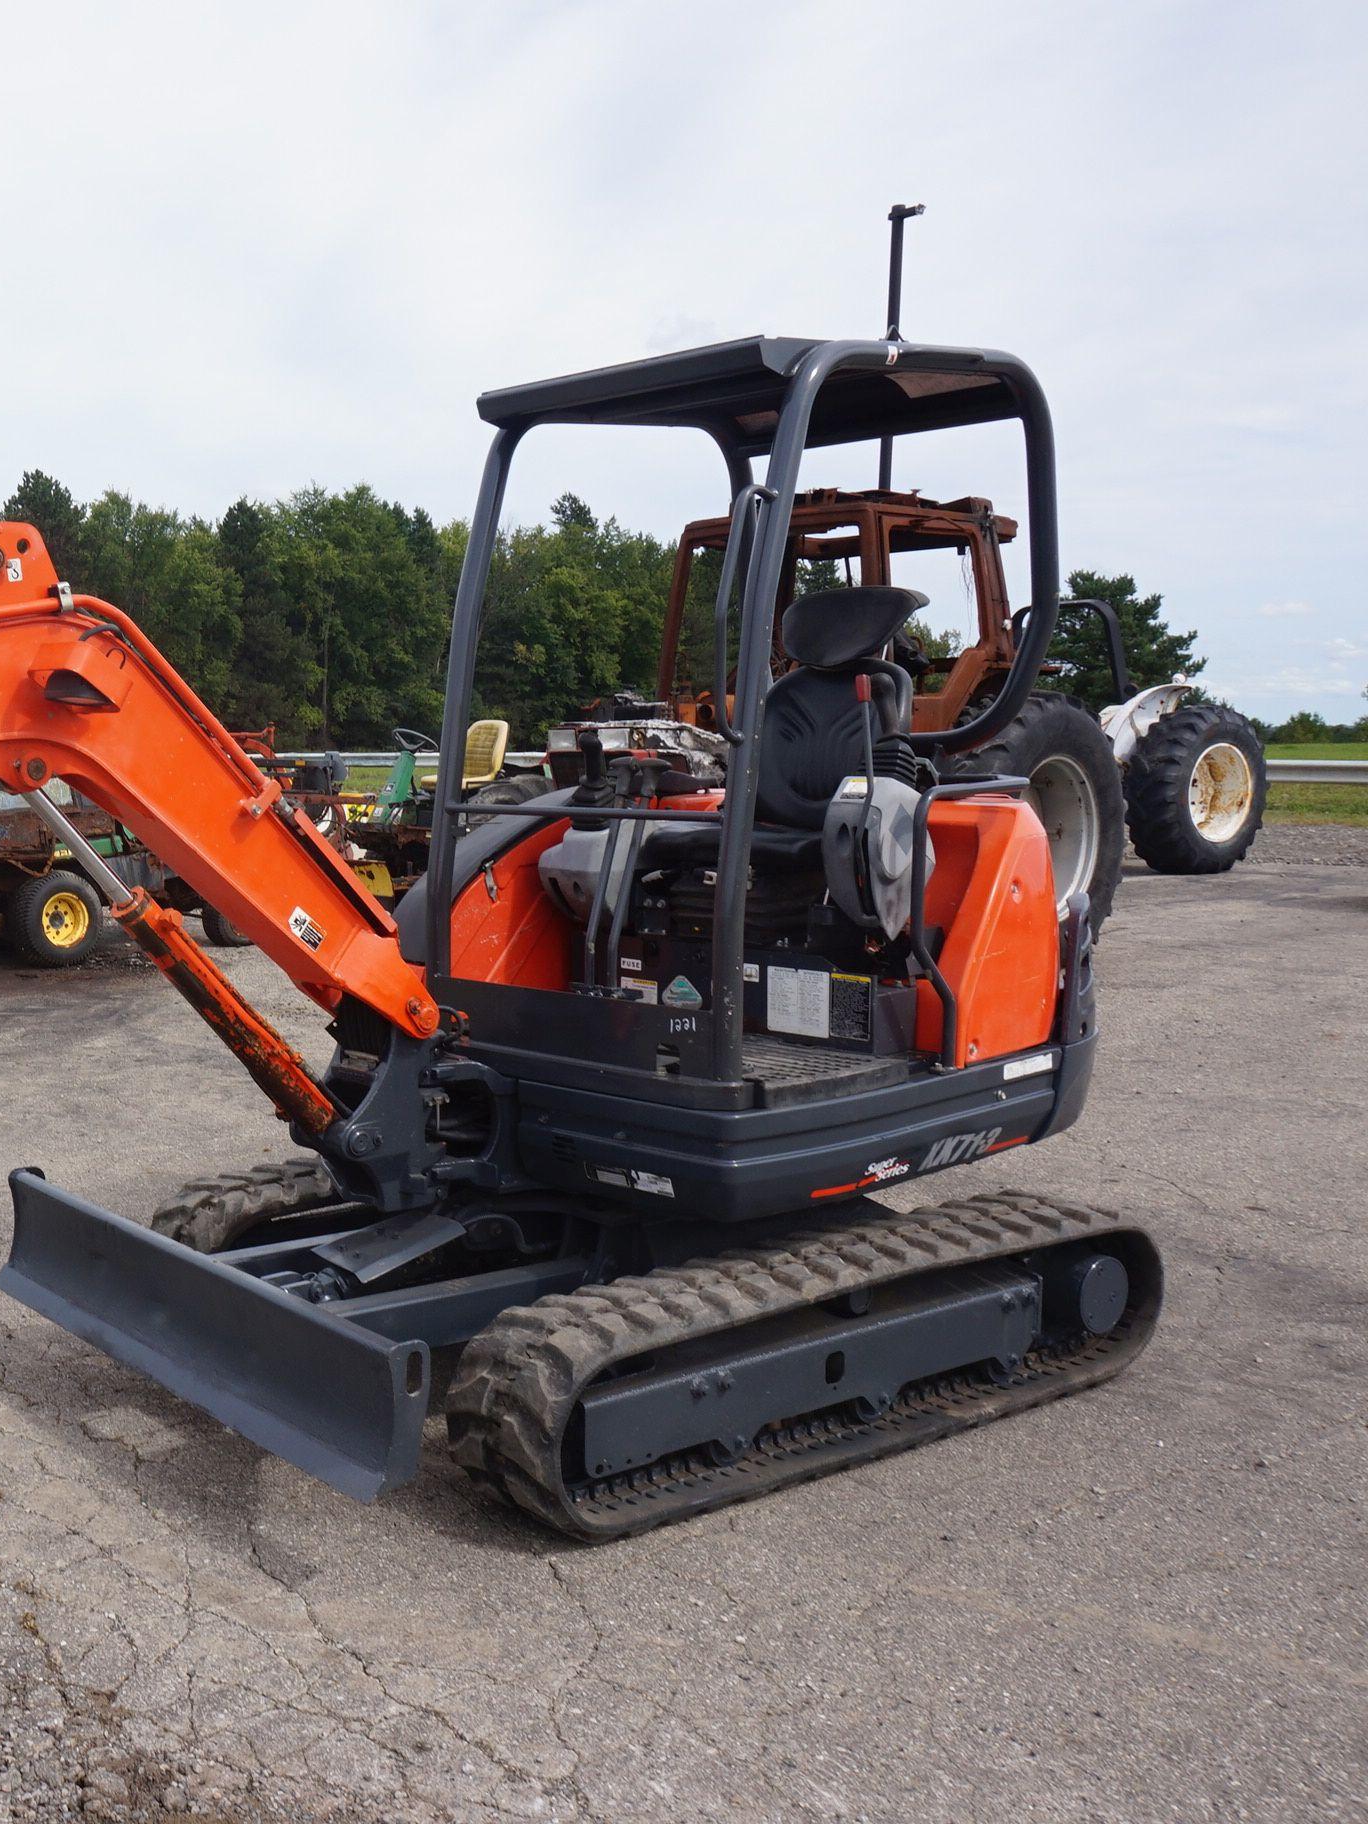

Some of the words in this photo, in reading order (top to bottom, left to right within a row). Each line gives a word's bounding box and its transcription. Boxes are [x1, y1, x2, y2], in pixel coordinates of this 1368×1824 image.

[622, 960, 640, 969] FUSE
[864, 1157, 898, 1176] Super
[875, 1163, 911, 1182] Series
